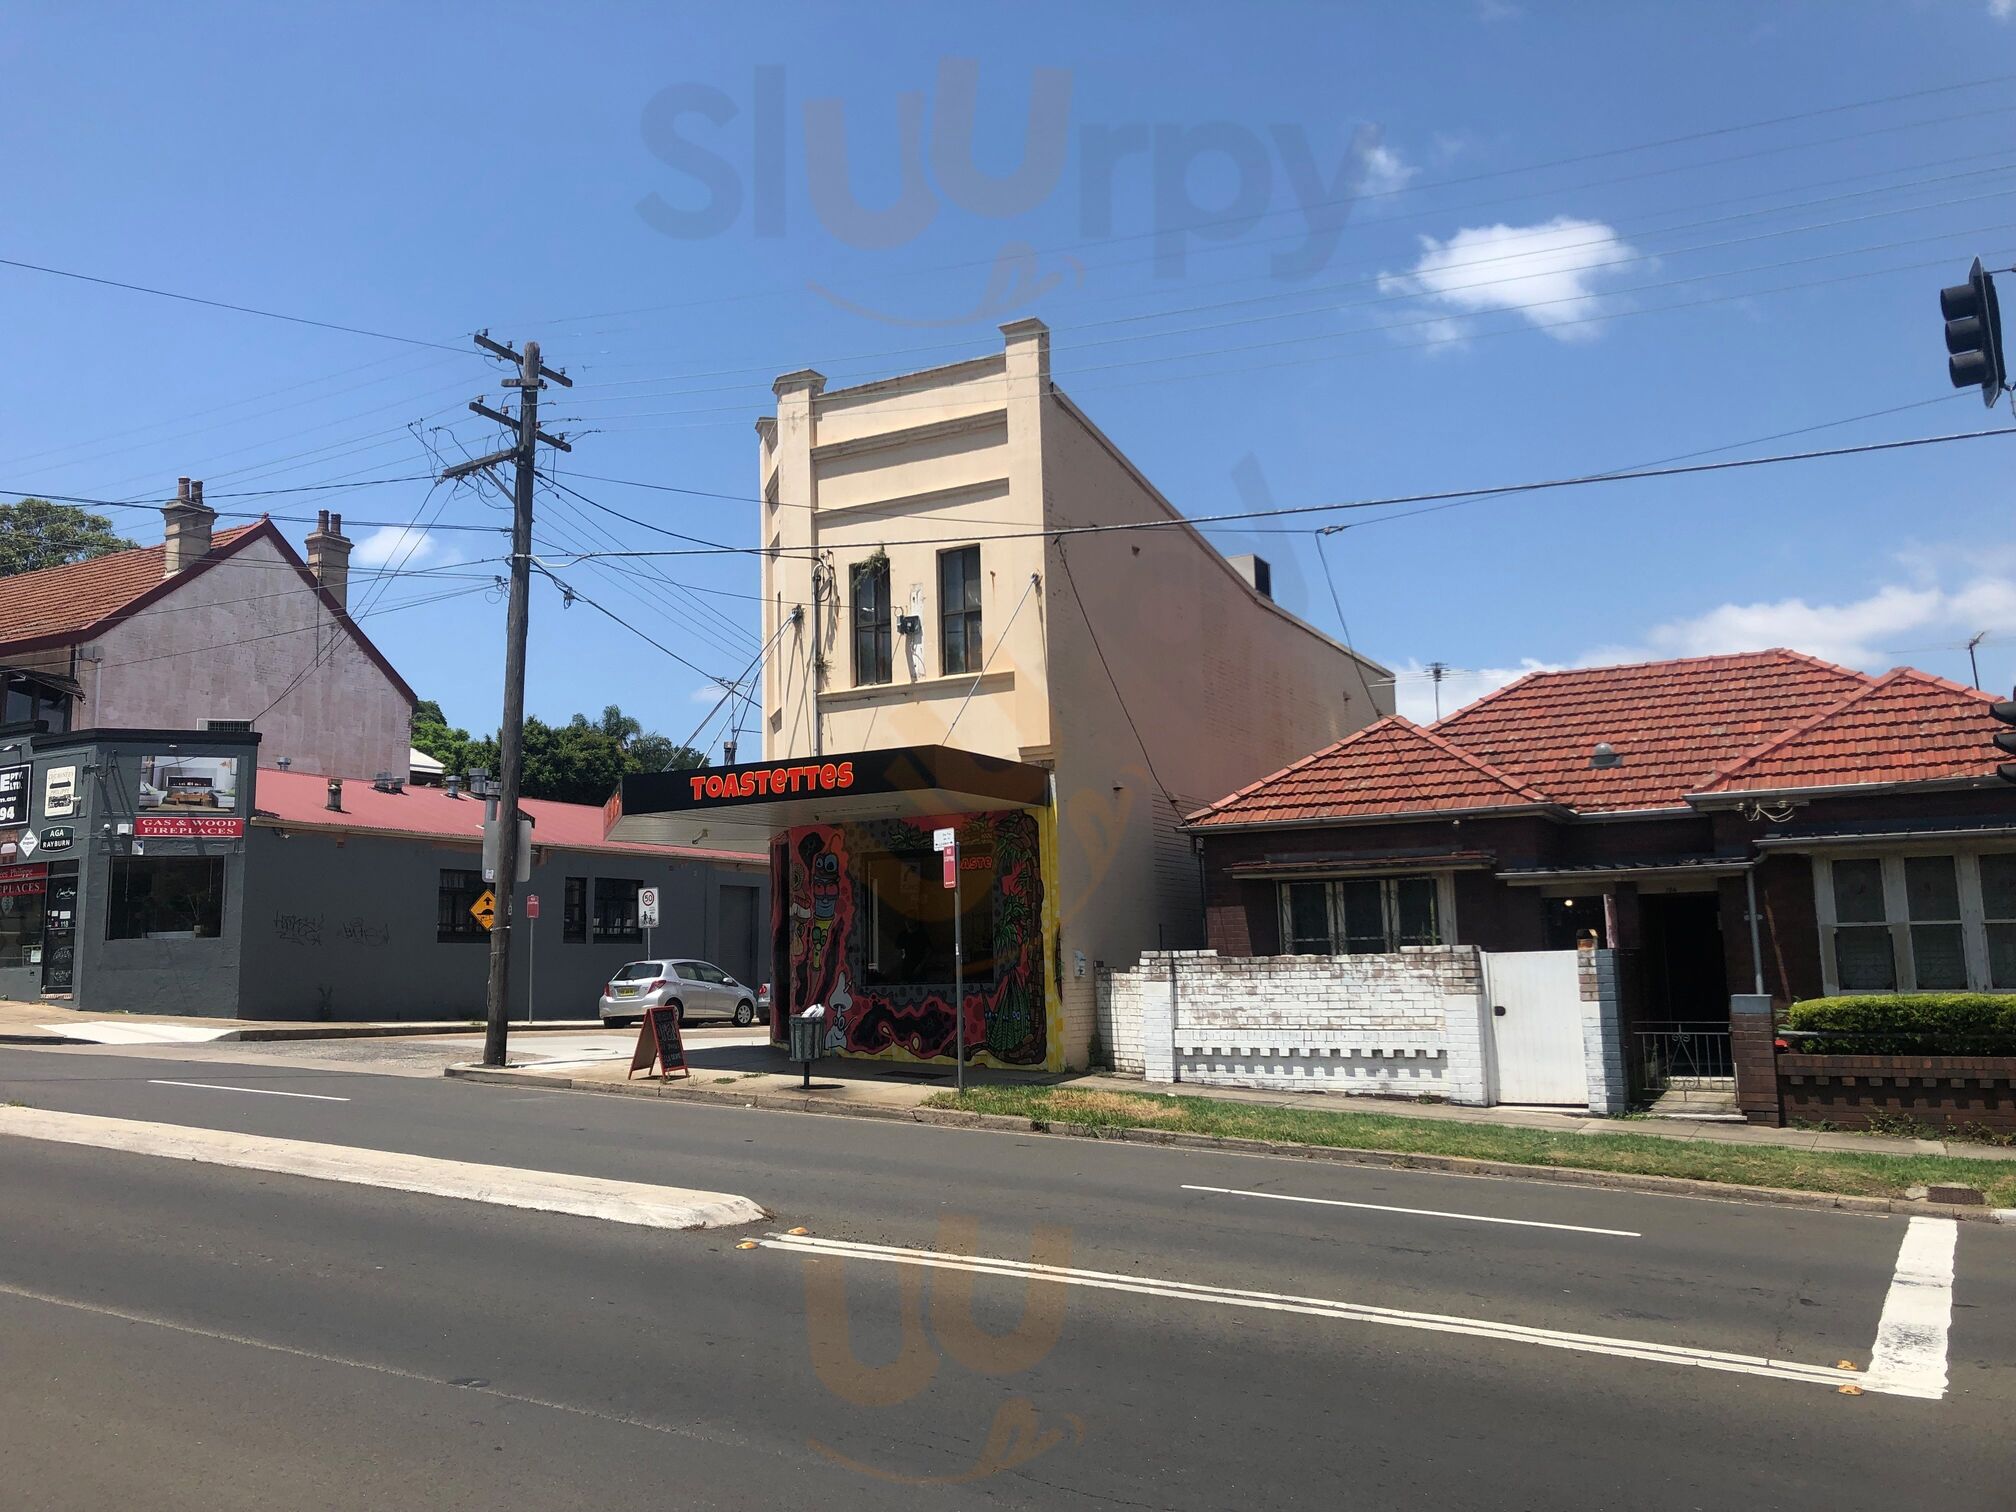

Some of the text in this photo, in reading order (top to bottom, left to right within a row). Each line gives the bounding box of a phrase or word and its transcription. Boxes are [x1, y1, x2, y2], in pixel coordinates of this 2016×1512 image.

[176, 819, 187, 827] &
[50, 829, 64, 837] AGA
[42, 840, 70, 848] RAYBURN
